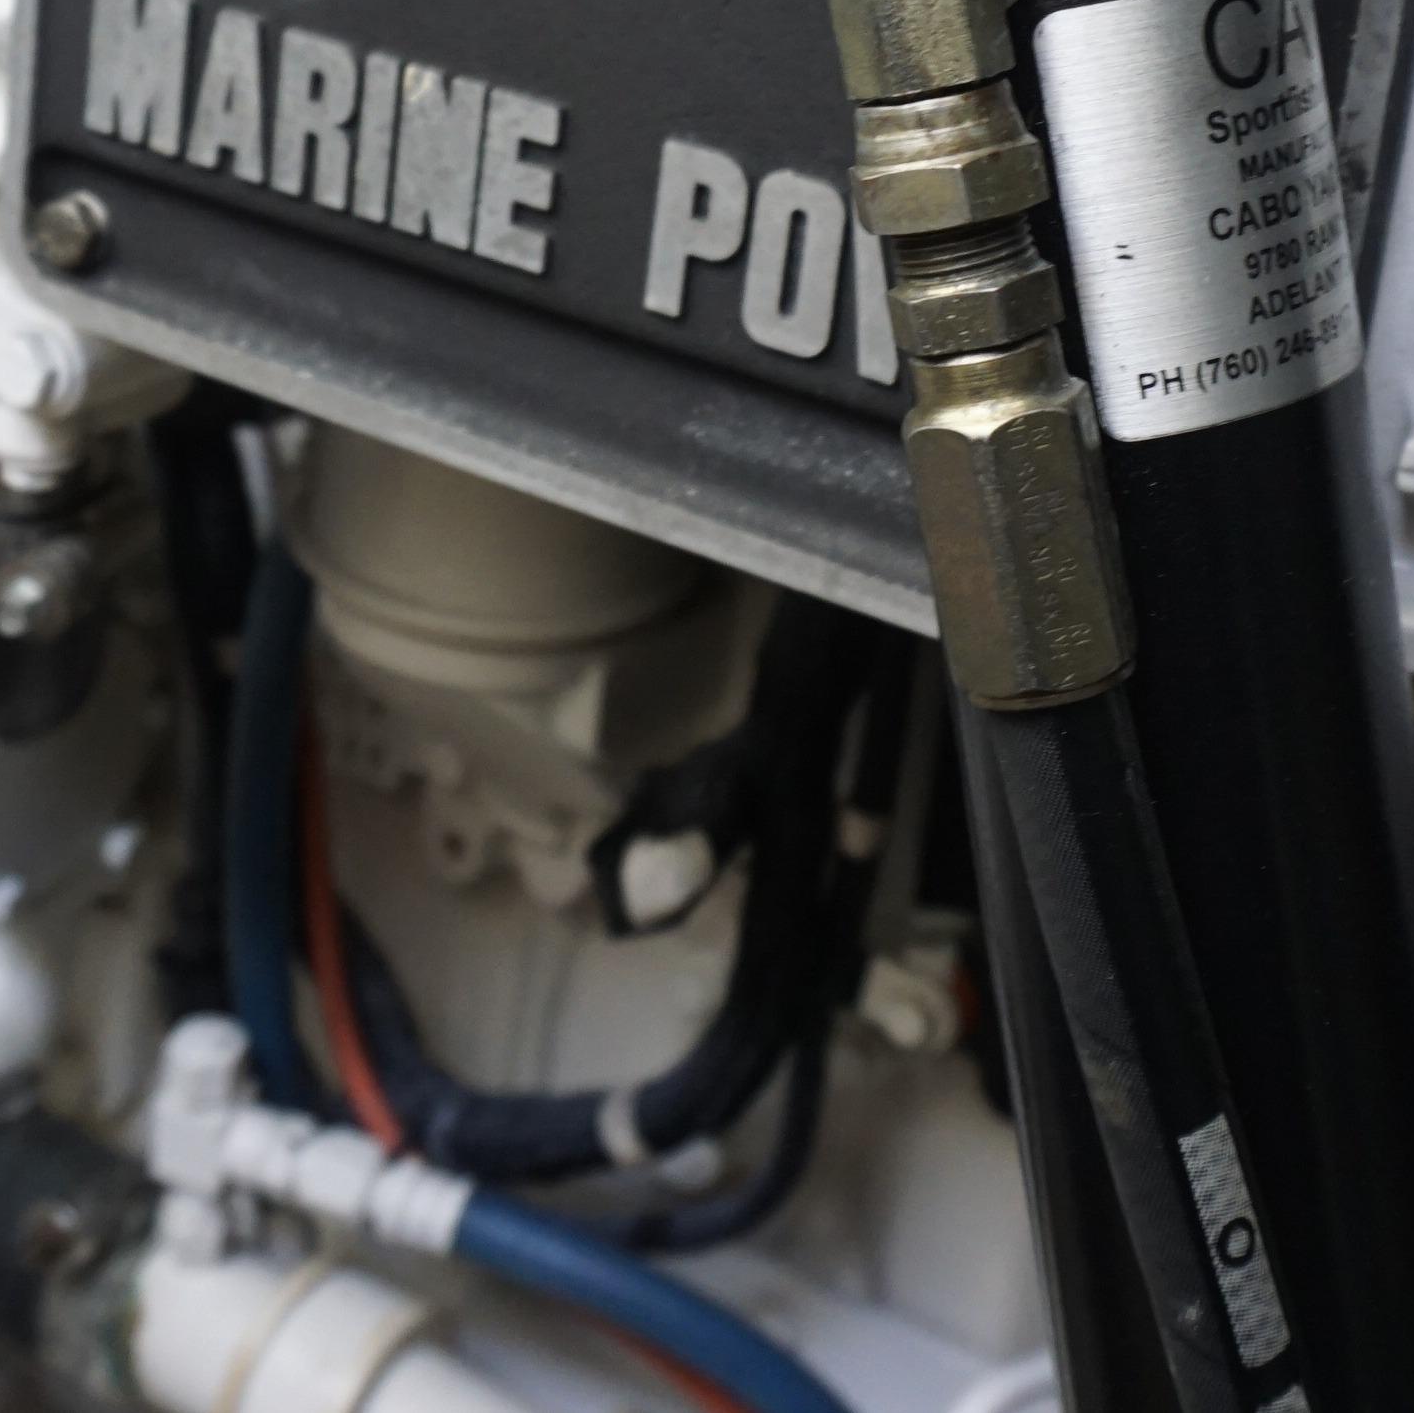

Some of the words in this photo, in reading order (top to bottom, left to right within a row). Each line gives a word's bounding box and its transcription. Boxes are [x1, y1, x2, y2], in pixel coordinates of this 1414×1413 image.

[1209, 185, 1302, 241] CABO
[1244, 238, 1302, 280] 9780
[1138, 366, 1186, 400] PH
[1195, 344, 1269, 394] (760)
